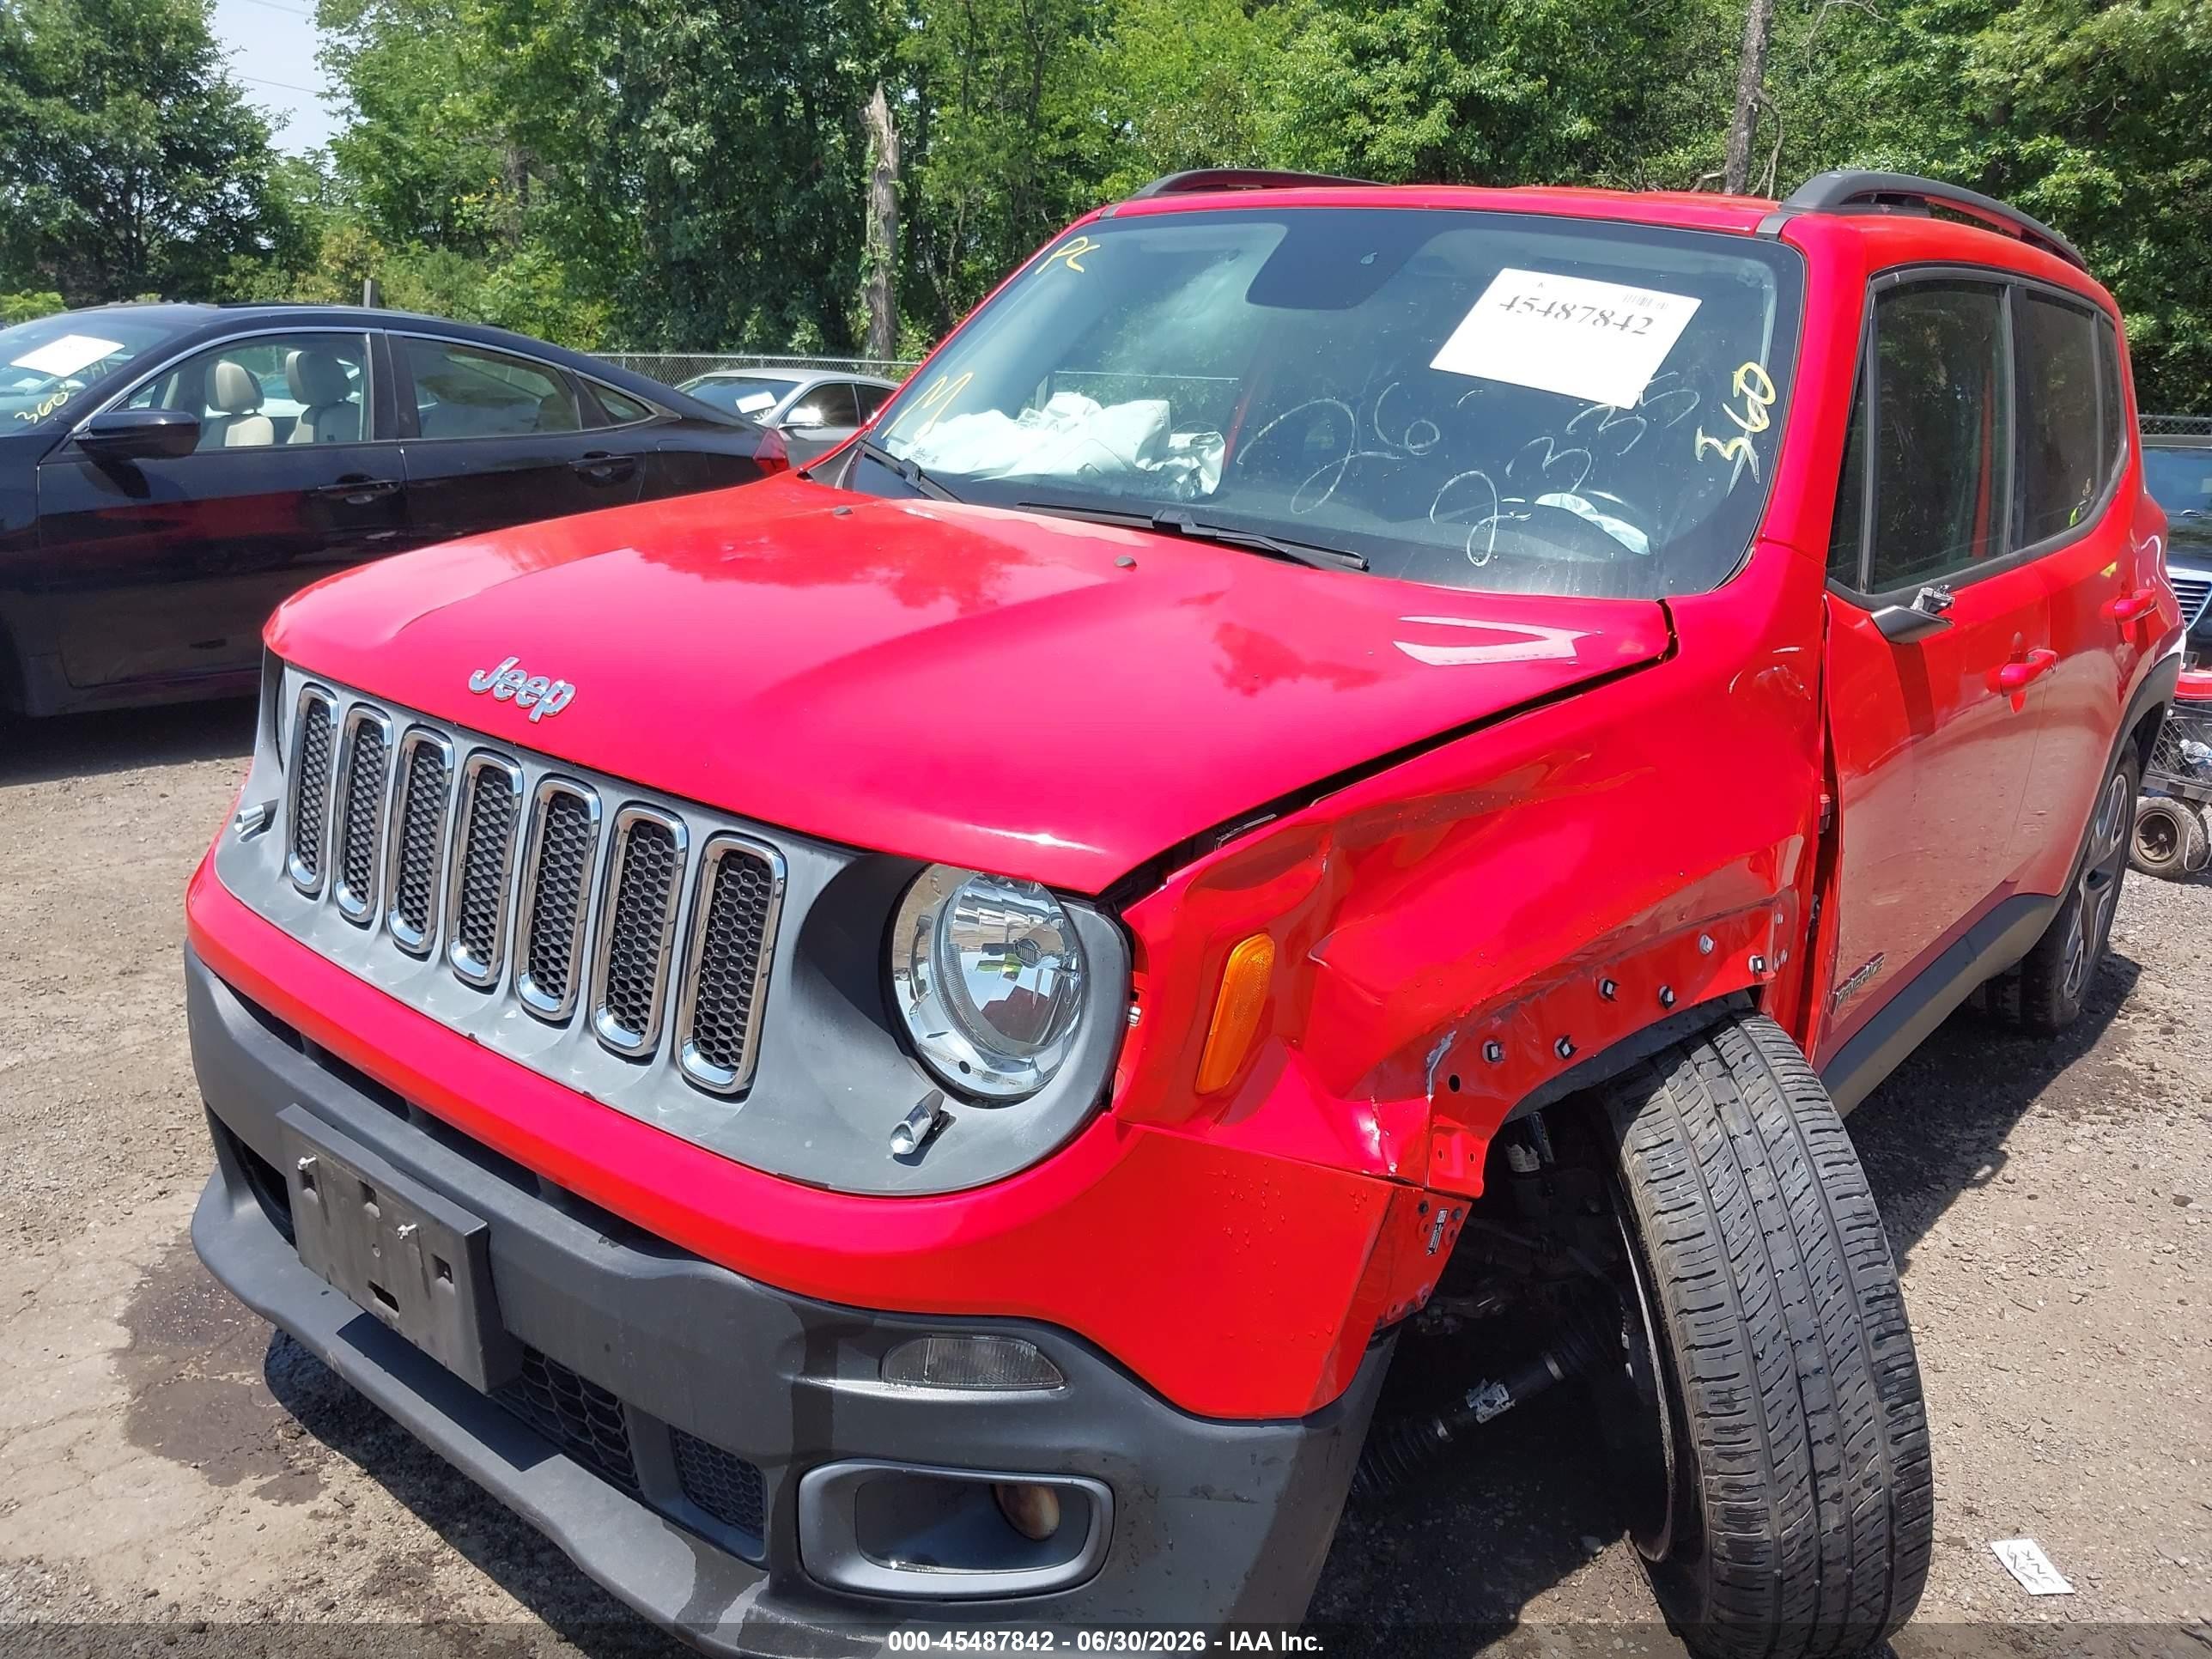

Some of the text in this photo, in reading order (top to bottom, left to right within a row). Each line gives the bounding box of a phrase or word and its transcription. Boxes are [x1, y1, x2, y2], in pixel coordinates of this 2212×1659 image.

[1498, 295, 1654, 335] 45487842
[14, 391, 70, 425] 360
[1694, 361, 1777, 484] 360
[468, 655, 577, 723] Jeep
